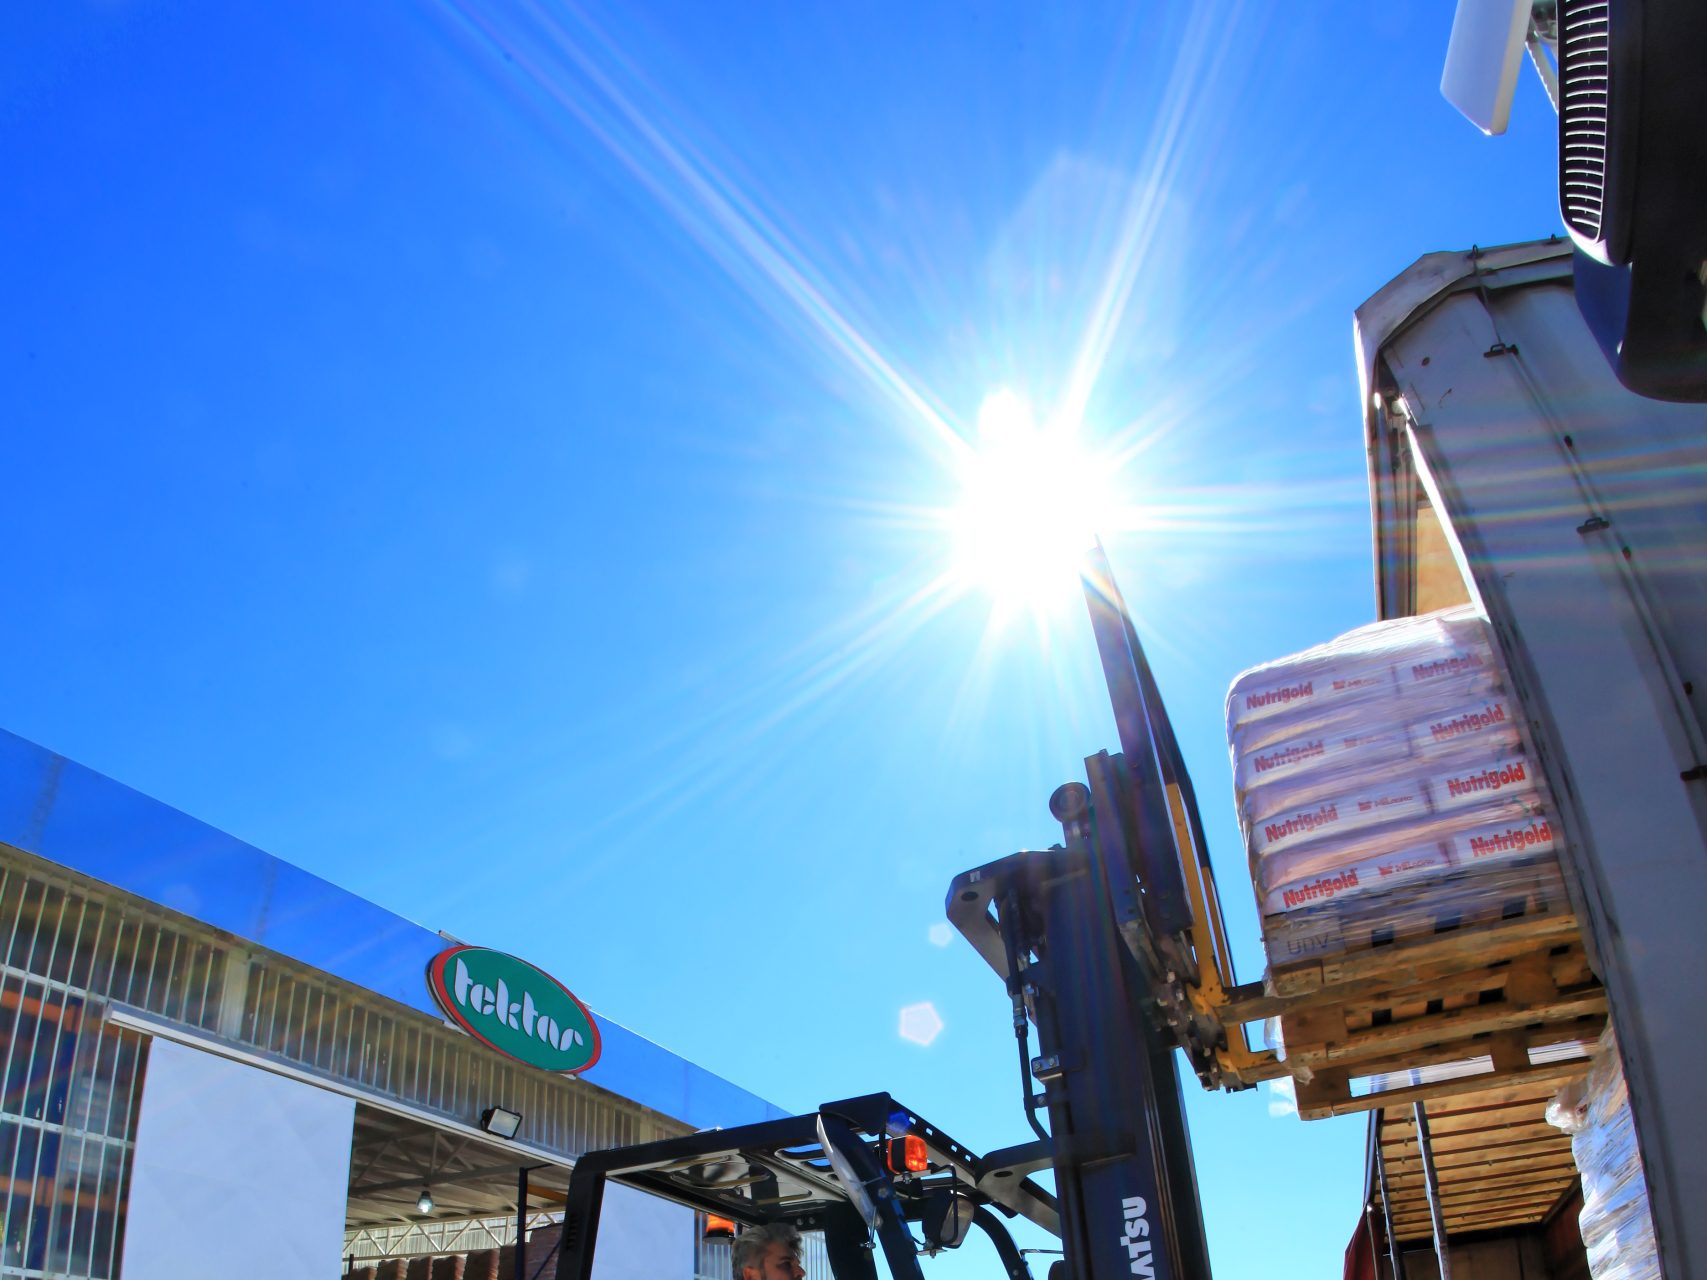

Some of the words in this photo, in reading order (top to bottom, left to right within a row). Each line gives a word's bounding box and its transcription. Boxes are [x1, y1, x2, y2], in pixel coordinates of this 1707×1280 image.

[1246, 682, 1313, 710] Nutrigold
[1430, 704, 1505, 741] Nutrigold
[1447, 762, 1526, 797] Nutrigold
[1265, 803, 1339, 843] Nutrigold
[1470, 822, 1553, 858] Nutrigold
[1282, 868, 1360, 908] Nutrigold
[454, 957, 583, 1051] tektar
